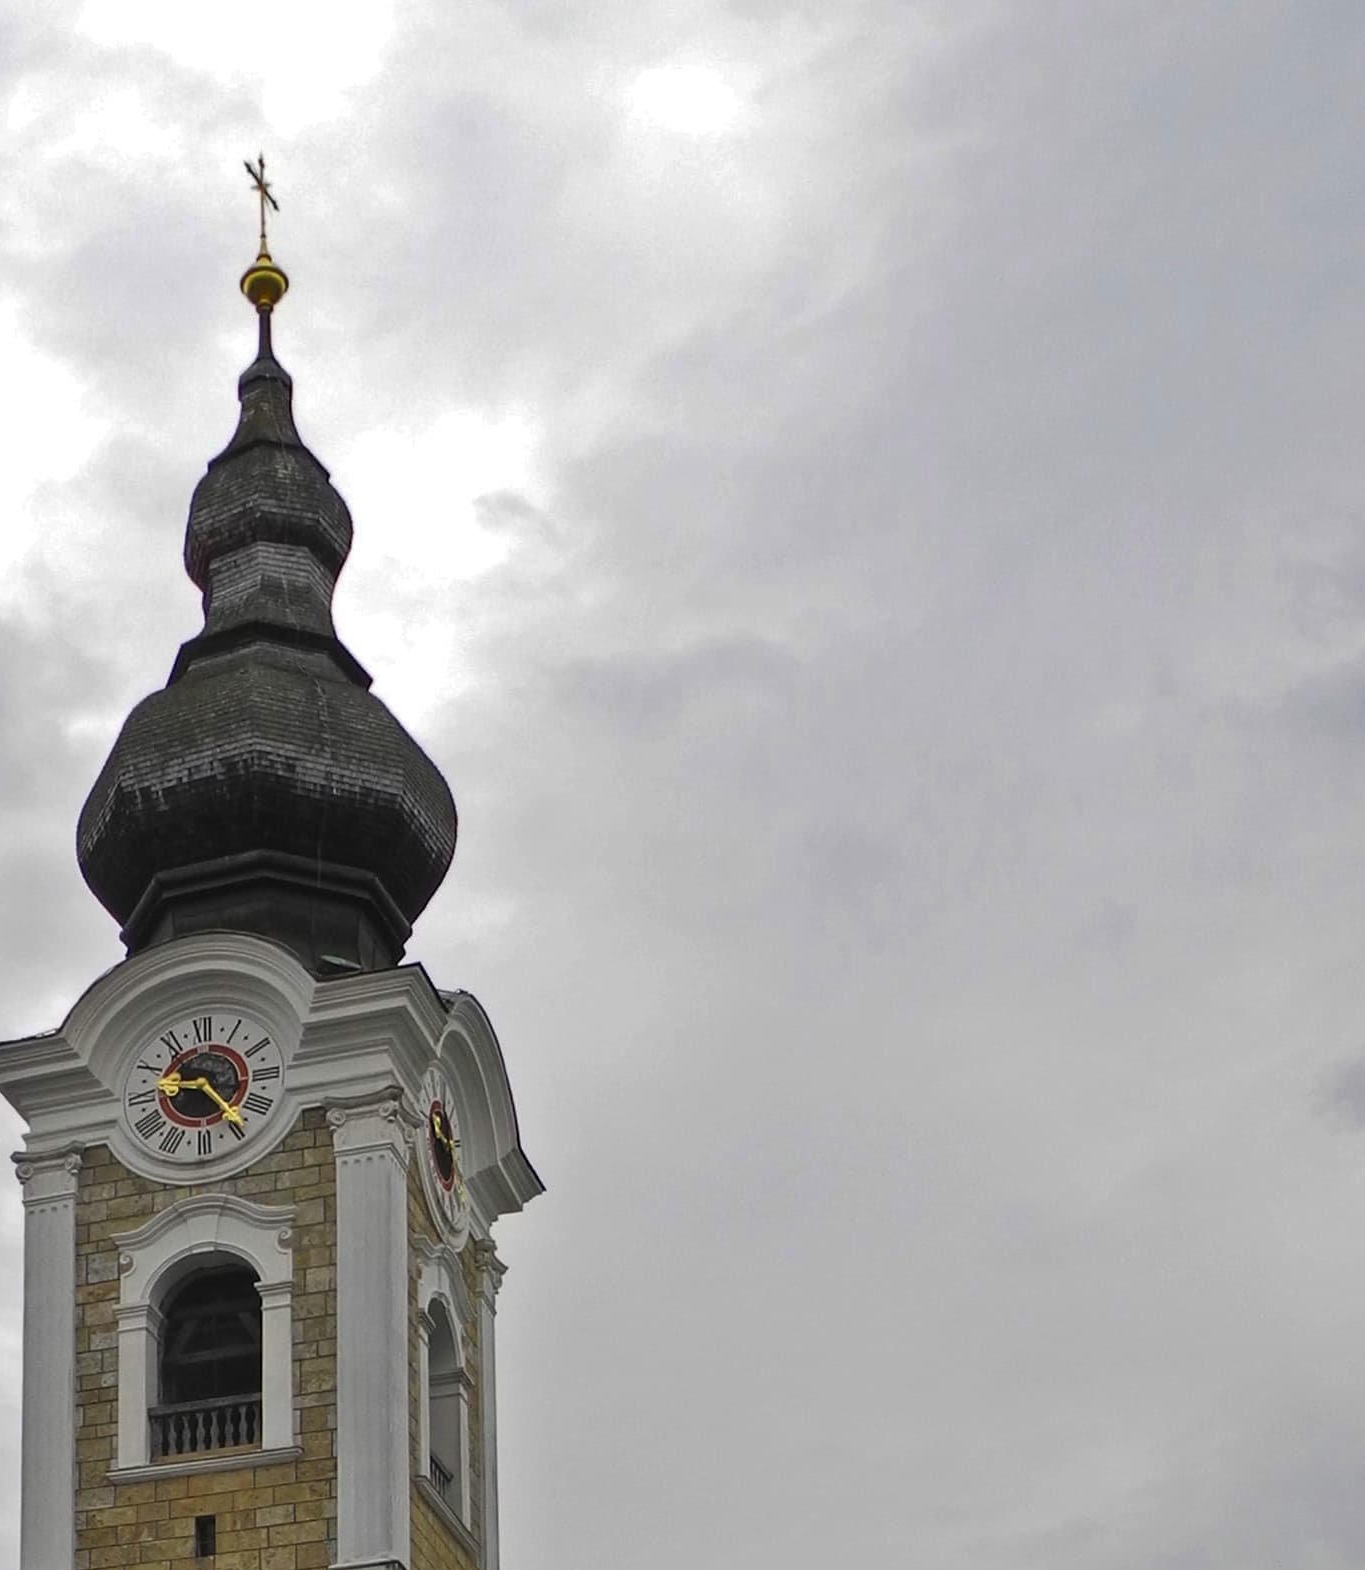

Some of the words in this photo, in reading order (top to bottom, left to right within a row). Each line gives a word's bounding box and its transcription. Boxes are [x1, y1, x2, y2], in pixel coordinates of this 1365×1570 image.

[193, 1016, 212, 1044] XII
[227, 1019, 242, 1043] I
[244, 1037, 270, 1058] II
[137, 1059, 163, 1076] X
[252, 1066, 280, 1082] III
